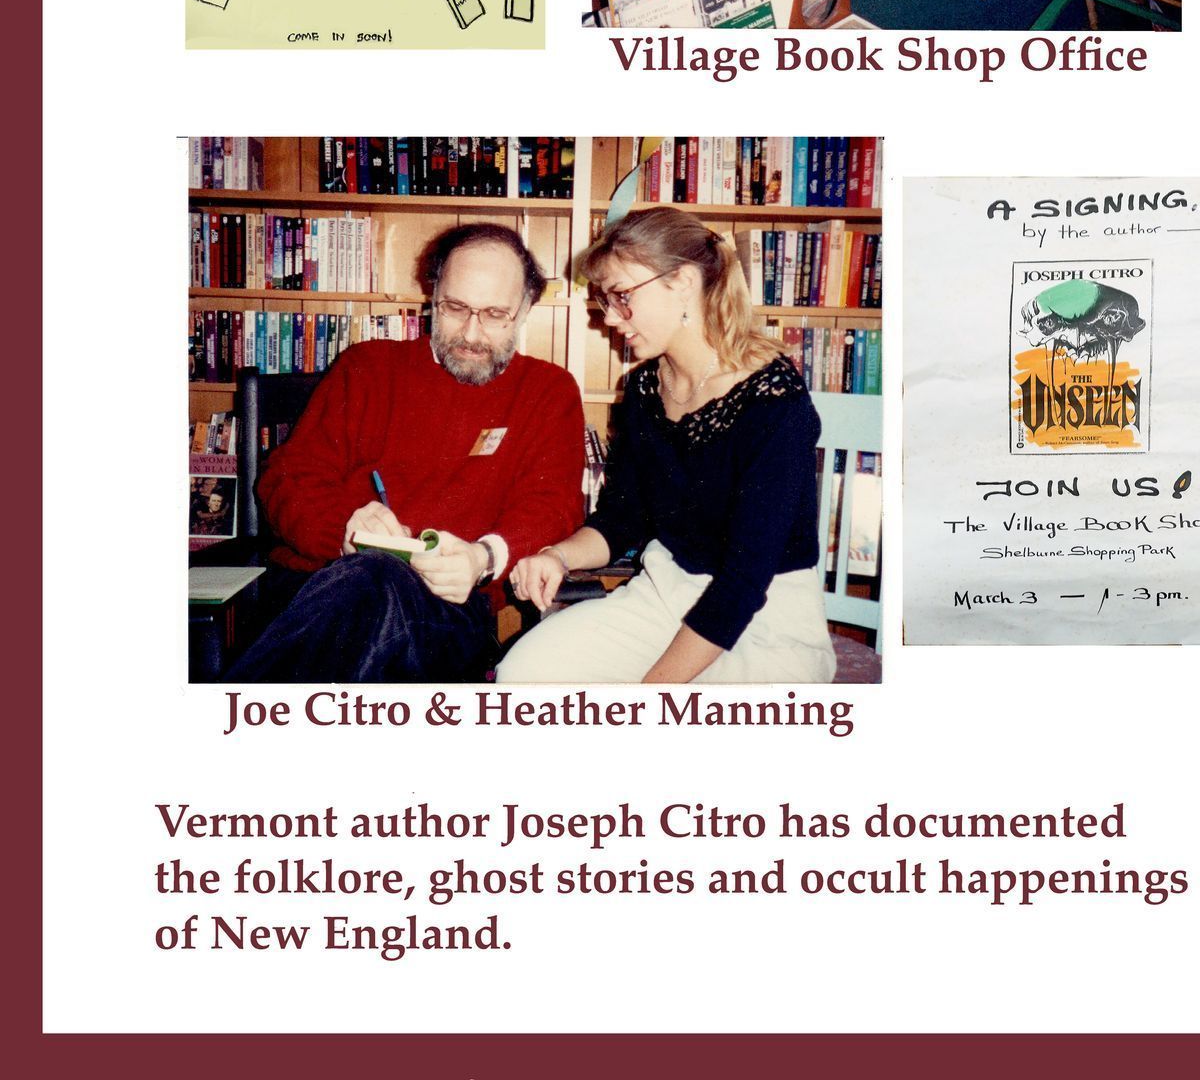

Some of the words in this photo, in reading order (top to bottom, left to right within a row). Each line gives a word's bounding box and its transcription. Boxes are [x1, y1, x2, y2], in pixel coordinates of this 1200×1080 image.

[287, 32, 320, 42] COME
[332, 32, 345, 42] IN
[356, 29, 393, 43] SOON!
[986, 199, 1017, 221] A
[1022, 223, 1047, 249] by
[1058, 224, 1090, 239] the
[1103, 224, 1162, 236] author
[1021, 270, 1084, 285] JOSEPH
[1089, 268, 1144, 280] CITRO
[1071, 374, 1093, 384] THE
[1019, 374, 1143, 435] UNSEEN
[976, 476, 1080, 501] JOIN
[943, 516, 987, 534] The
[1003, 512, 1069, 539] Village
[979, 546, 1065, 560] Shelburne
[1068, 546, 1137, 563] Shopping
[954, 590, 1014, 610] March
[1018, 591, 1038, 605] 3
[1132, 587, 1151, 601] 3
